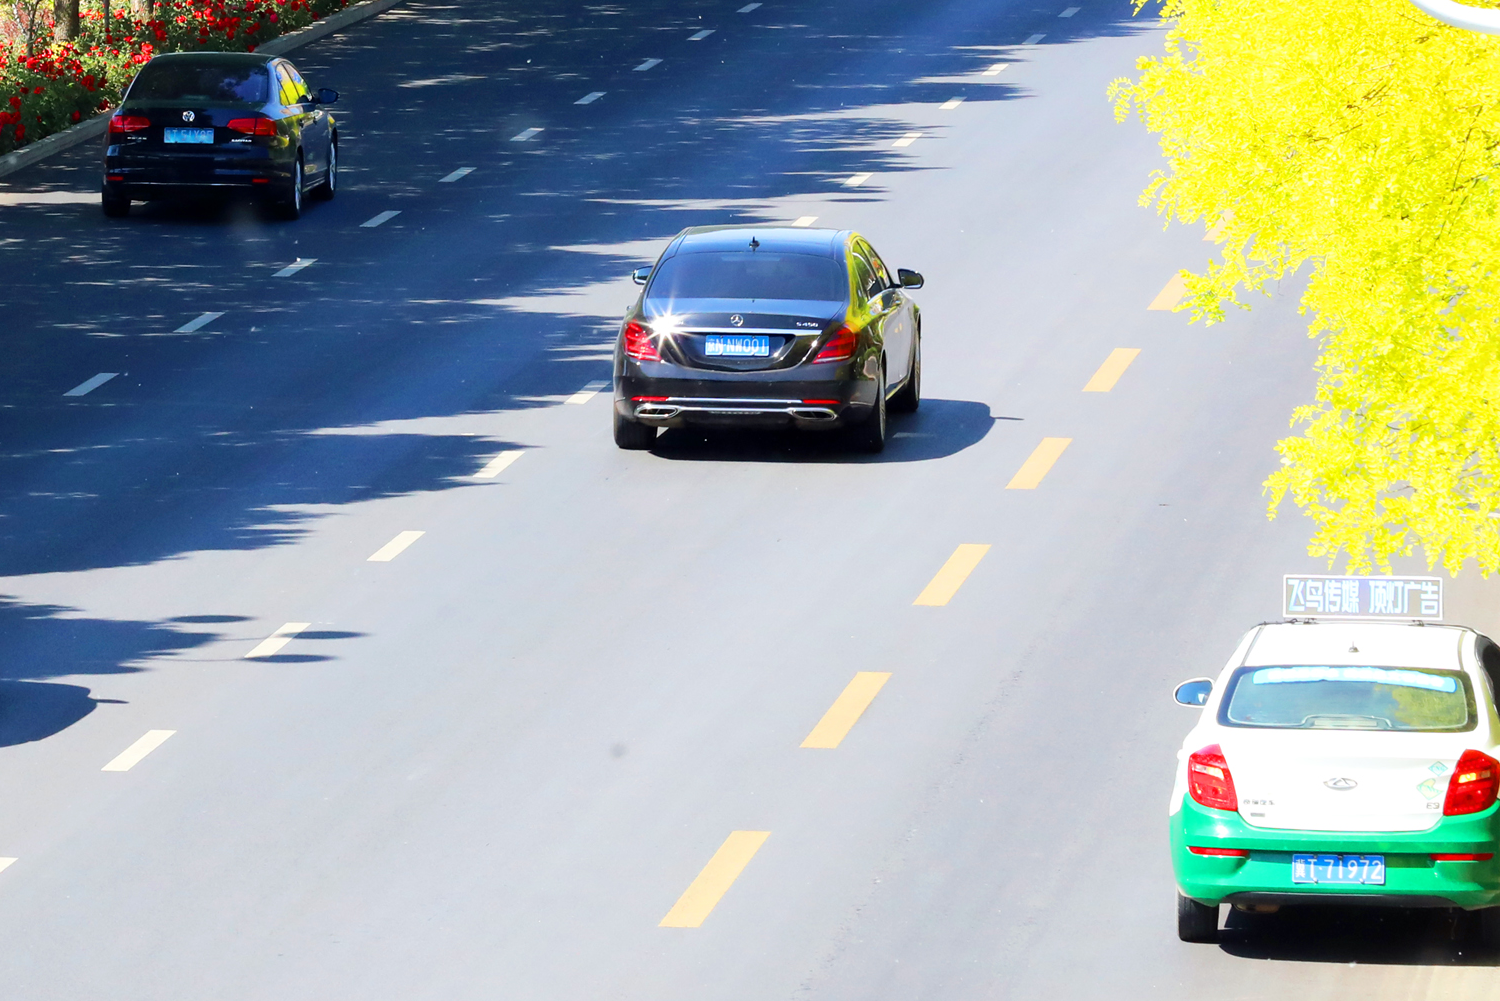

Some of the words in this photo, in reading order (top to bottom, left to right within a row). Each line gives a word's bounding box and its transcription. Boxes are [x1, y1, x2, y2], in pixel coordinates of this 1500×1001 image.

[1287, 579, 1360, 613] 飞鸟传媒
[1369, 580, 1439, 615] 顶灯广告
